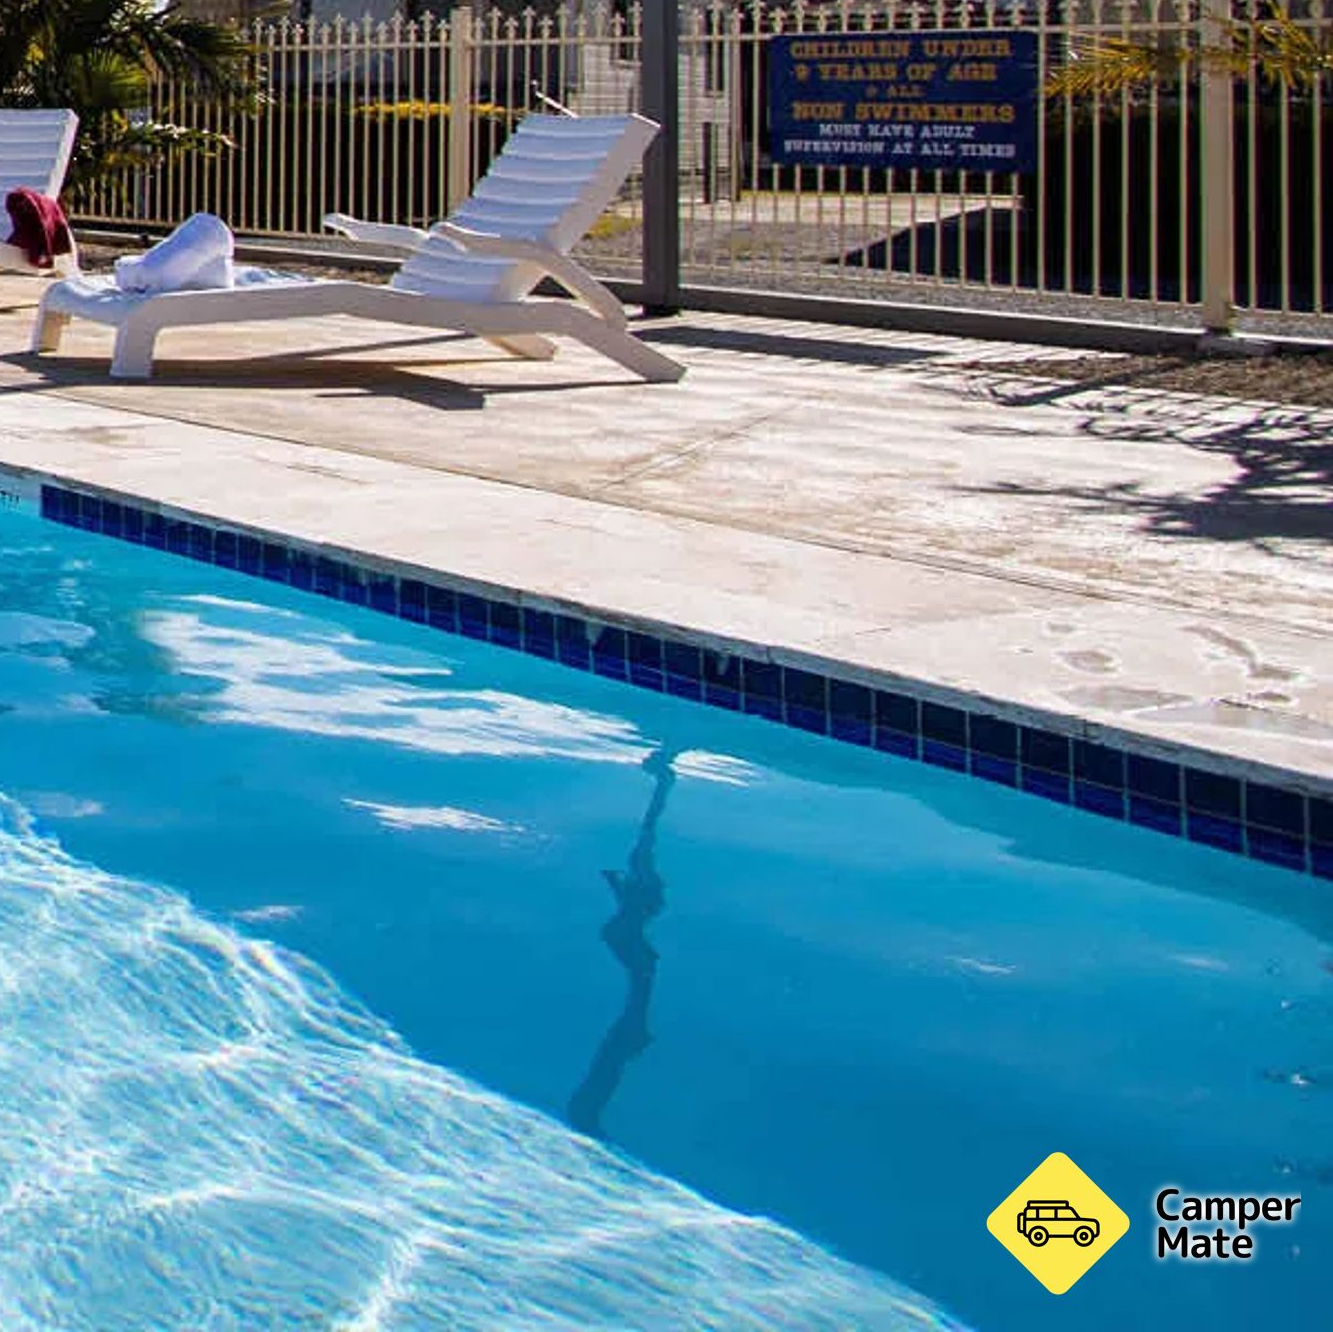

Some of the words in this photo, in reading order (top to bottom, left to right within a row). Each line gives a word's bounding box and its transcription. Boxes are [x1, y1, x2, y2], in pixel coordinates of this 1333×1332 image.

[923, 40, 1010, 57] UNDER
[819, 64, 897, 80] YEARS
[906, 63, 936, 81] OF
[947, 63, 998, 81] AGE
[792, 102, 845, 121] NON
[855, 102, 1015, 123] SWIMMERS
[819, 123, 862, 137] MUST
[868, 124, 914, 137] HAVE
[919, 124, 976, 138] ADULT
[784, 139, 885, 153] SUPERVISION
[891, 142, 913, 154] AT
[920, 142, 955, 156] ALL
[960, 143, 1016, 158] TIMES
